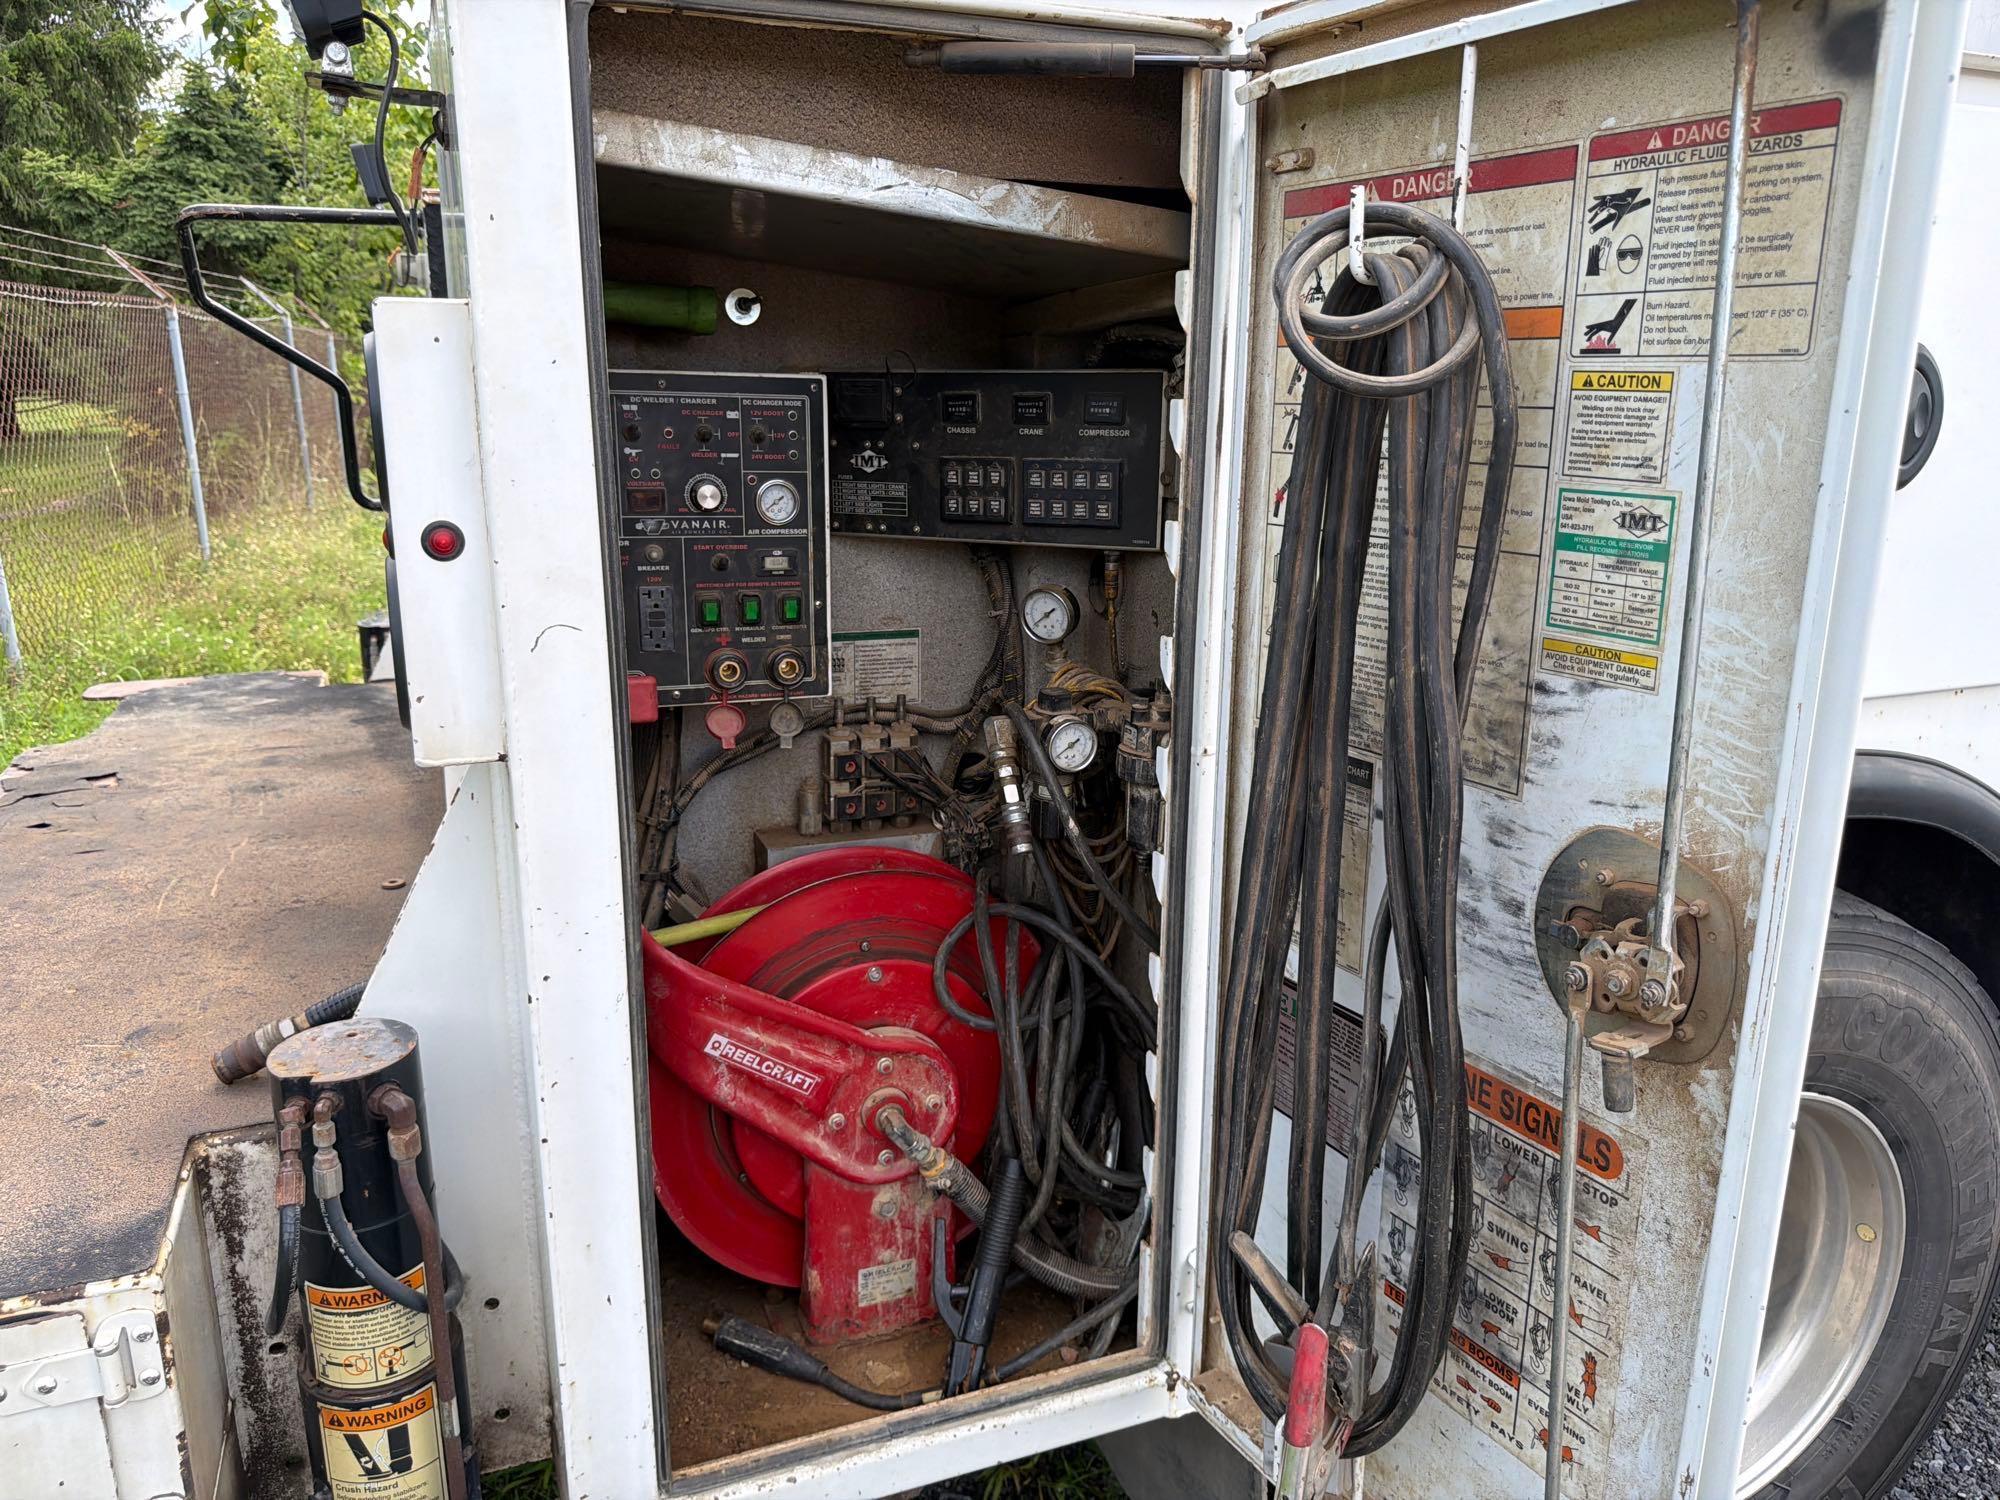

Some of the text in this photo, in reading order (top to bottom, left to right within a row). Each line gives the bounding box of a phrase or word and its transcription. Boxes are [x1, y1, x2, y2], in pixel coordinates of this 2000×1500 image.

[1673, 116, 1761, 146] DANGR
[1614, 134, 1803, 172] HYDRAULIC FLUID ZARDS
[1659, 173, 1708, 186] High pressure
[1748, 178, 1778, 188] working
[1658, 186, 1719, 198] Release pressure
[1656, 204, 1678, 214] Detect
[1680, 202, 1700, 212] leaks
[1656, 214, 1696, 224] Wear sturdy
[1495, 225, 1524, 234] equipment
[1654, 225, 1680, 235] NEVER
[1757, 232, 1794, 243] surgically
[1652, 242, 1668, 250] Fluid
[1670, 240, 1697, 250] injected
[1746, 243, 1792, 253] immediately
[1650, 248, 1718, 260] removed by trained
[1658, 260, 1691, 271] gangrene
[1648, 277, 1665, 285] Fluid
[1666, 276, 1694, 286] injected
[1656, 314, 1702, 322] temperatures
[1644, 326, 1654, 334] Do
[1654, 326, 1666, 334] not
[1643, 337, 1682, 346] Hot surface
[1597, 374, 1662, 388] CAUTION
[643, 396, 674, 404] WELDER
[1582, 404, 1604, 412] Welding
[1624, 414, 1646, 422] damage
[1019, 428, 1044, 436] CRANE
[1078, 428, 1130, 437] COMPRESSOR
[854, 455, 885, 468] IMT
[1576, 496, 1590, 504] Mold
[1591, 498, 1610, 507] Tooling
[1582, 506, 1595, 514] Iowa
[671, 520, 727, 529] VANAIR
[1620, 511, 1662, 532] IMT
[1590, 546, 1649, 558] RECOMMENDATIONS
[1619, 542, 1654, 550] RESERVOIR
[1560, 559, 1588, 568] HYDRAULIC
[1616, 559, 1640, 567] AMBIENT
[1598, 564, 1658, 576] TEMPERATURE RANGE
[1592, 612, 1608, 620] Above
[1576, 645, 1622, 661] CAUTION
[1545, 652, 1652, 678] AVOID EQUIPMENT DAMAGE
[1553, 660, 1574, 671] Check
[1577, 665, 1586, 673] oil
[1588, 668, 1604, 676] level
[722, 1044, 814, 1090] REELCRAFT
[1500, 1088, 1611, 1173] SIGNLS
[1494, 1132, 1540, 1166] LOWER
[1843, 992, 1998, 1378] CONTINENTAL
[1582, 1182, 1618, 1208] STOP
[1487, 1220, 1528, 1254] SWING
[1484, 1288, 1519, 1318] LOWER
[1485, 1302, 1514, 1326] BOOM
[1469, 1339, 1513, 1382] BOOMS
[1450, 1350, 1513, 1402] RETRACT BOOM
[1433, 1378, 1480, 1416] SAFETY
[346, 1398, 426, 1427] WARNING
[1490, 1421, 1524, 1450] PAYS
[335, 1482, 398, 1493] Crush Hazard
